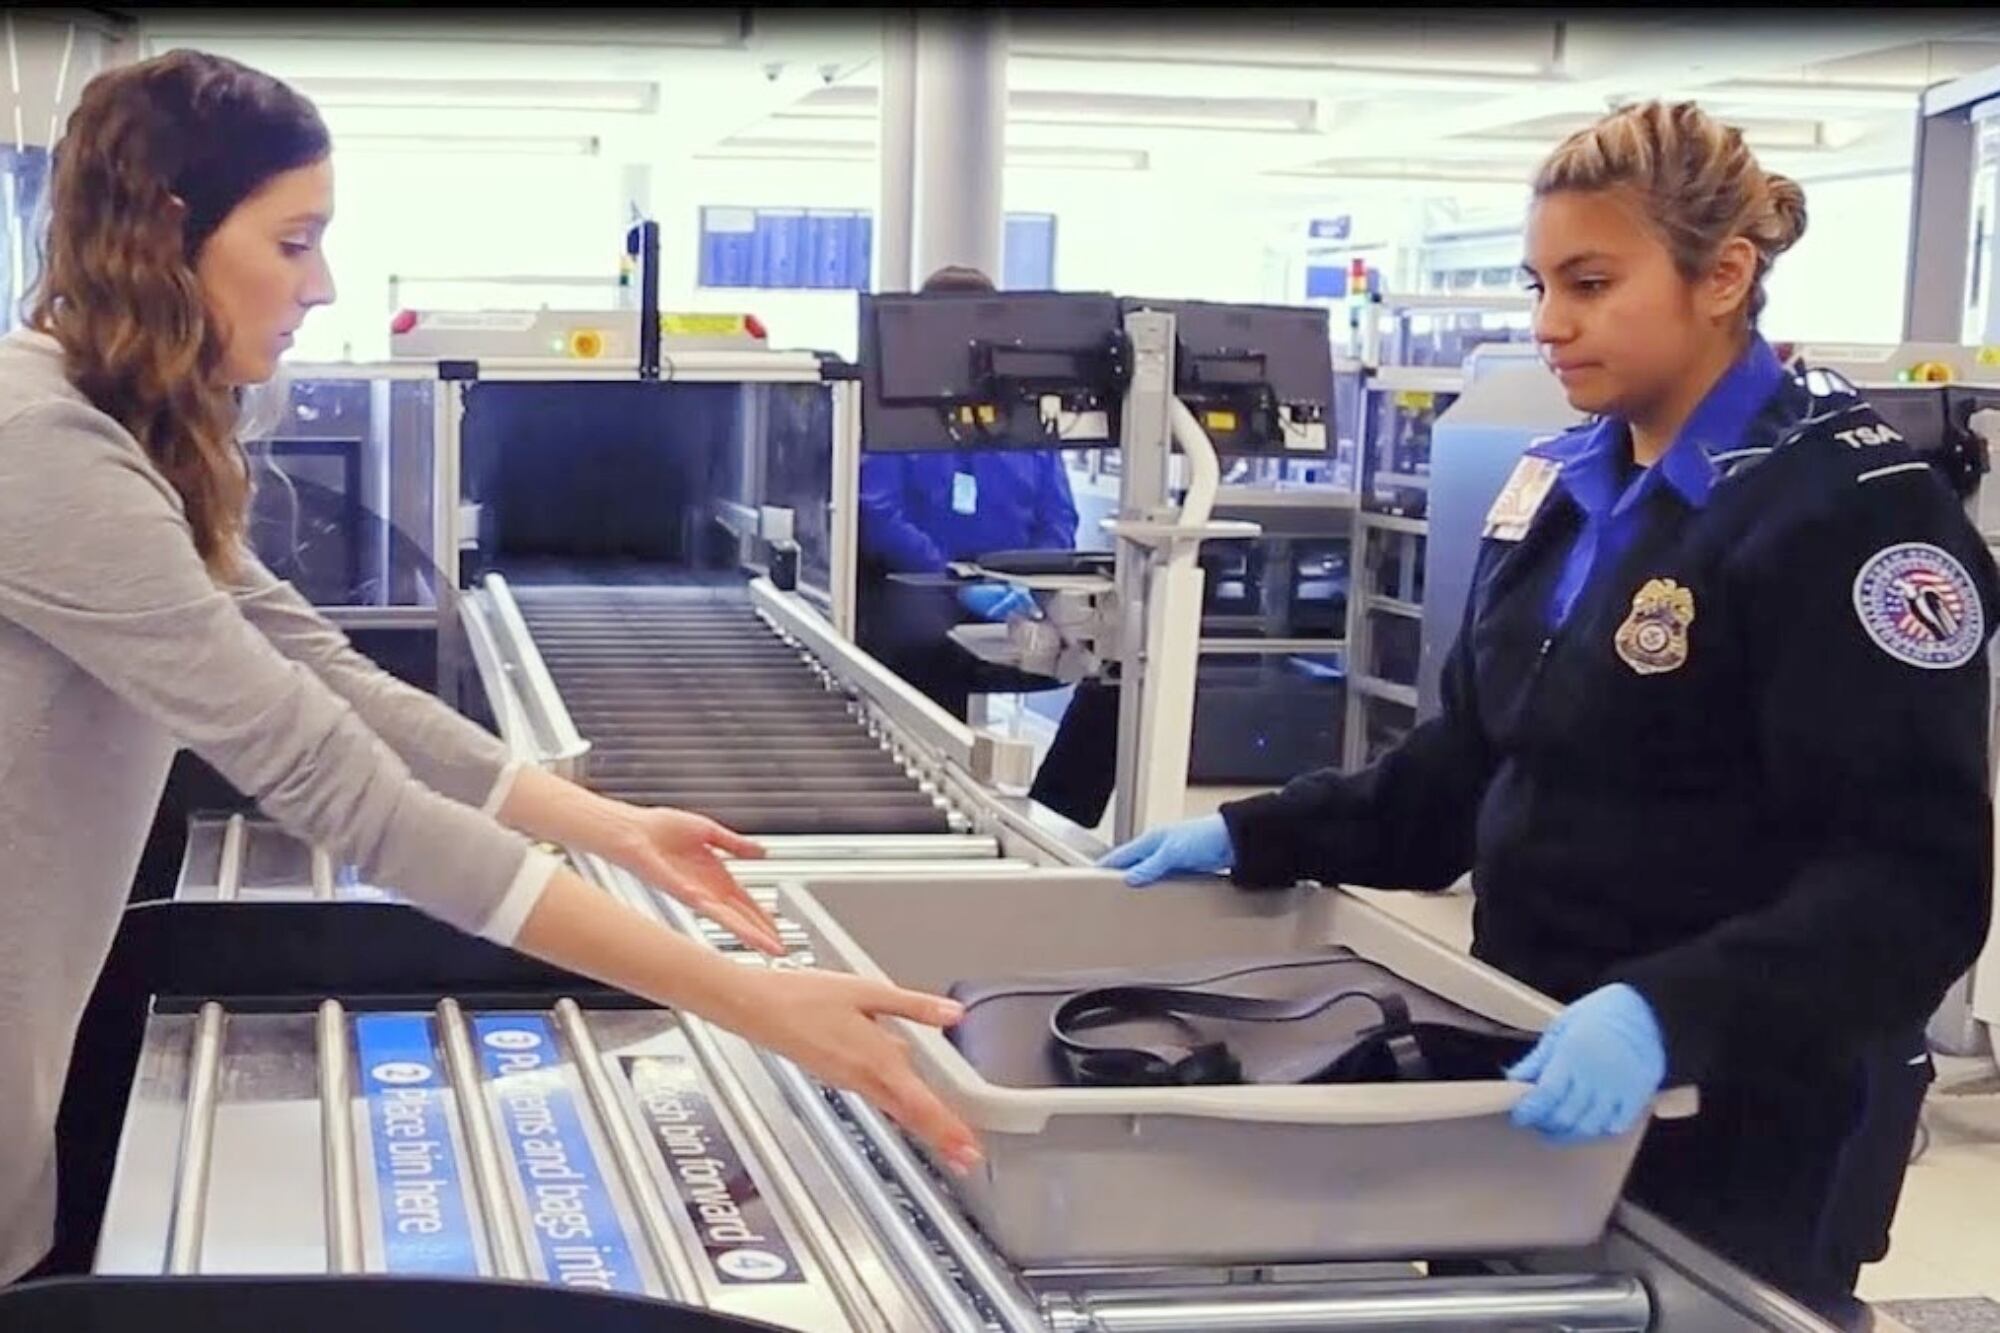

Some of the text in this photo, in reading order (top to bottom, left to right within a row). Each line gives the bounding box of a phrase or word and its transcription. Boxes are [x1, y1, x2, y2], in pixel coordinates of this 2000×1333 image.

[1834, 424, 1904, 449] TSA
[388, 1141, 443, 1176] bin
[520, 1140, 586, 1181] and
[658, 1124, 712, 1156] bin
[393, 1180, 449, 1234] here
[534, 1183, 593, 1240] bags
[673, 1157, 766, 1242] forward
